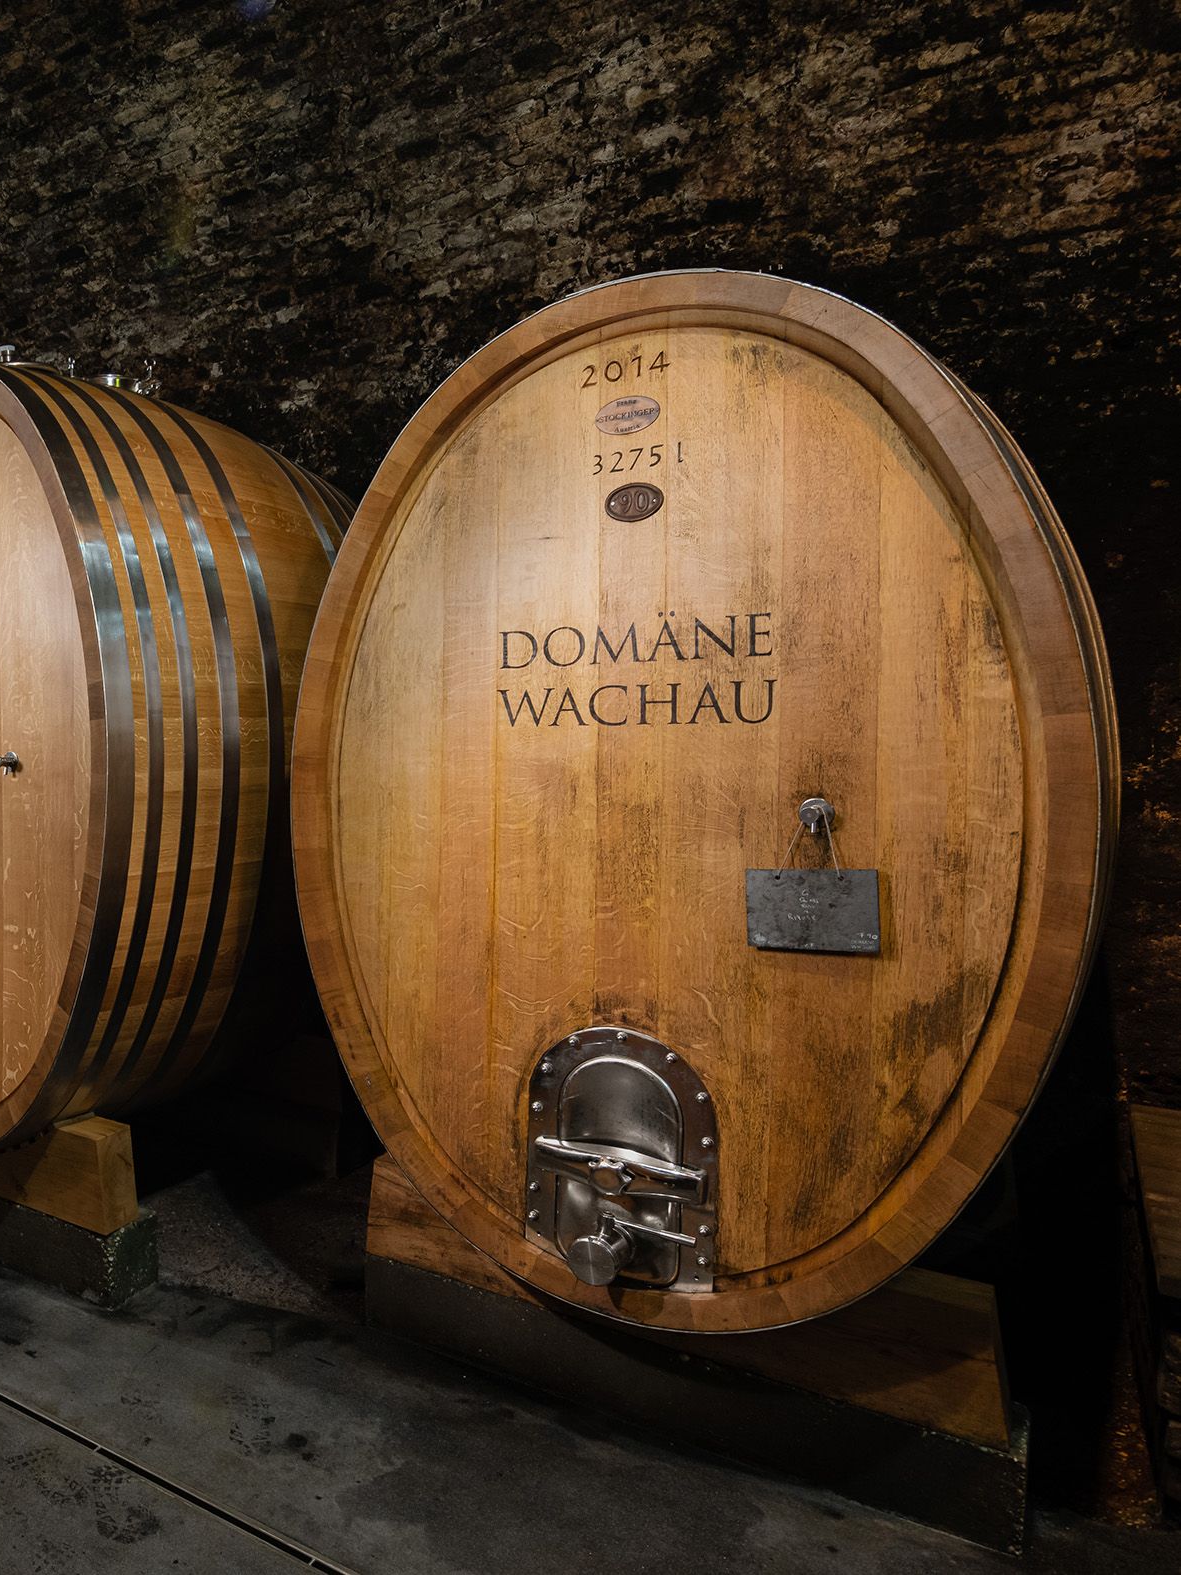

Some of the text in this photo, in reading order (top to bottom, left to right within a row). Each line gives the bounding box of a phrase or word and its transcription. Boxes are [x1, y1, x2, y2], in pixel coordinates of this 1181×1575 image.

[580, 350, 670, 389] 2014
[597, 408, 655, 425] STOCKINGER
[592, 444, 664, 476] 3275
[618, 489, 650, 513] 90
[499, 610, 773, 669] DOMÄNE
[497, 679, 778, 727] WACHAU
